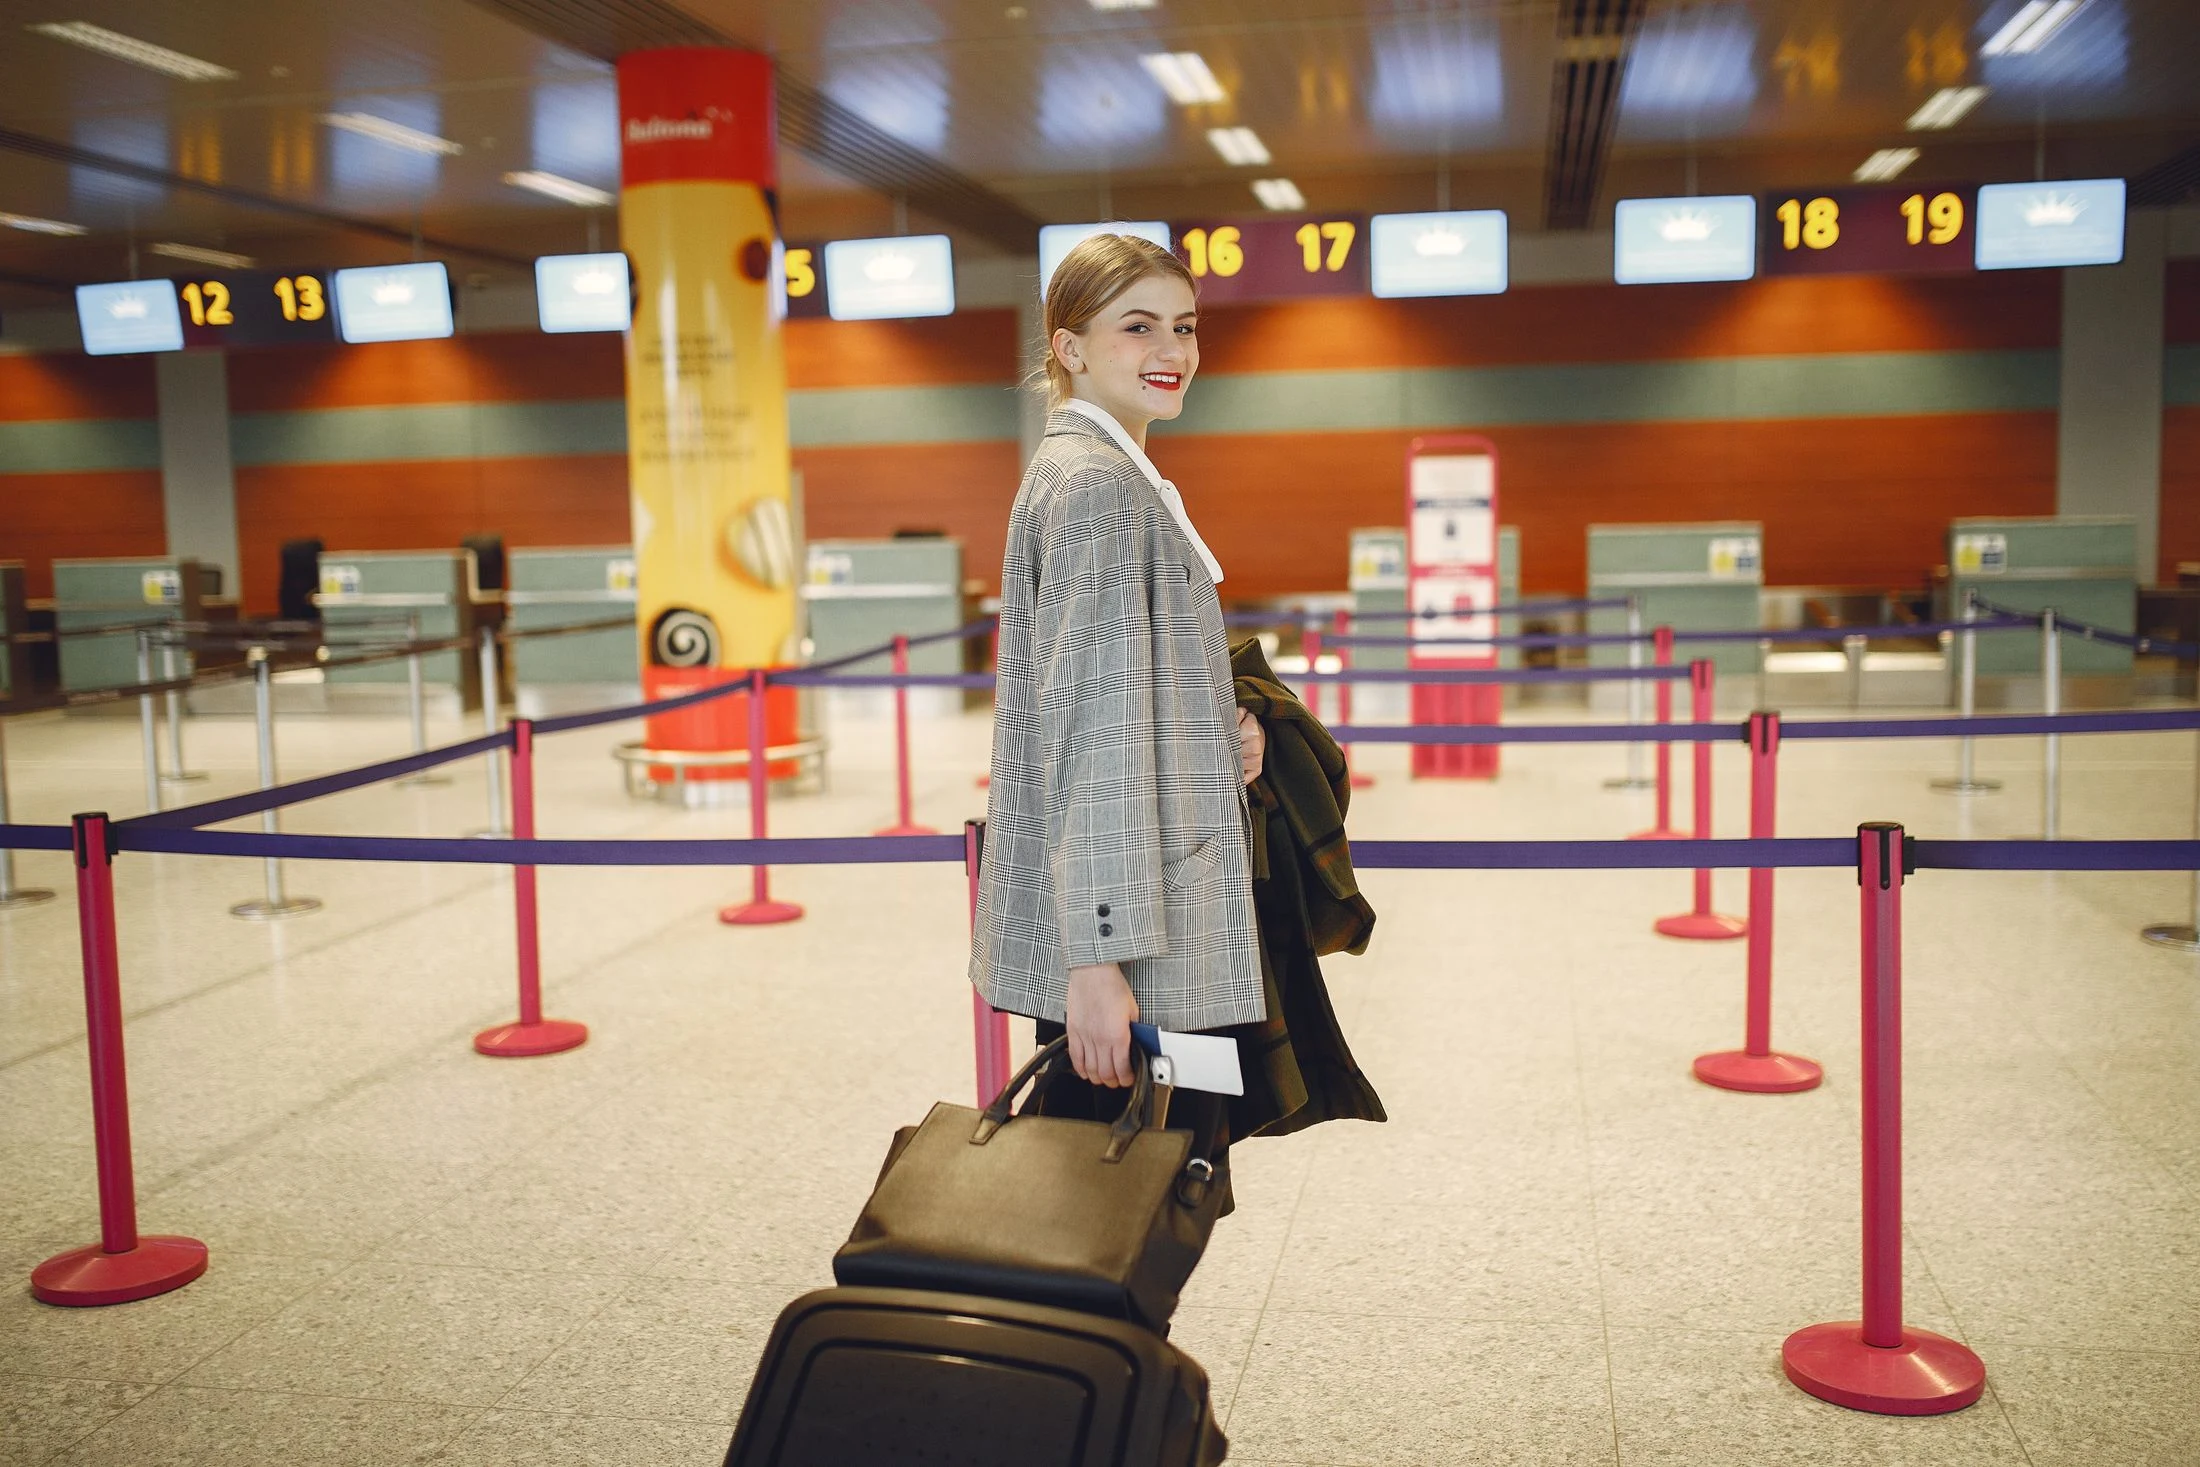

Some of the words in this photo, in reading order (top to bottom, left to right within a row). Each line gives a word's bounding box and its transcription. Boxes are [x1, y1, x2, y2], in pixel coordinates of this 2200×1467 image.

[1182, 226, 1244, 278] 16
[1295, 221, 1356, 273] 17
[1776, 197, 1840, 250] 18
[1900, 192, 1964, 245] 19
[182, 280, 234, 326] 12
[273, 275, 325, 321] 13
